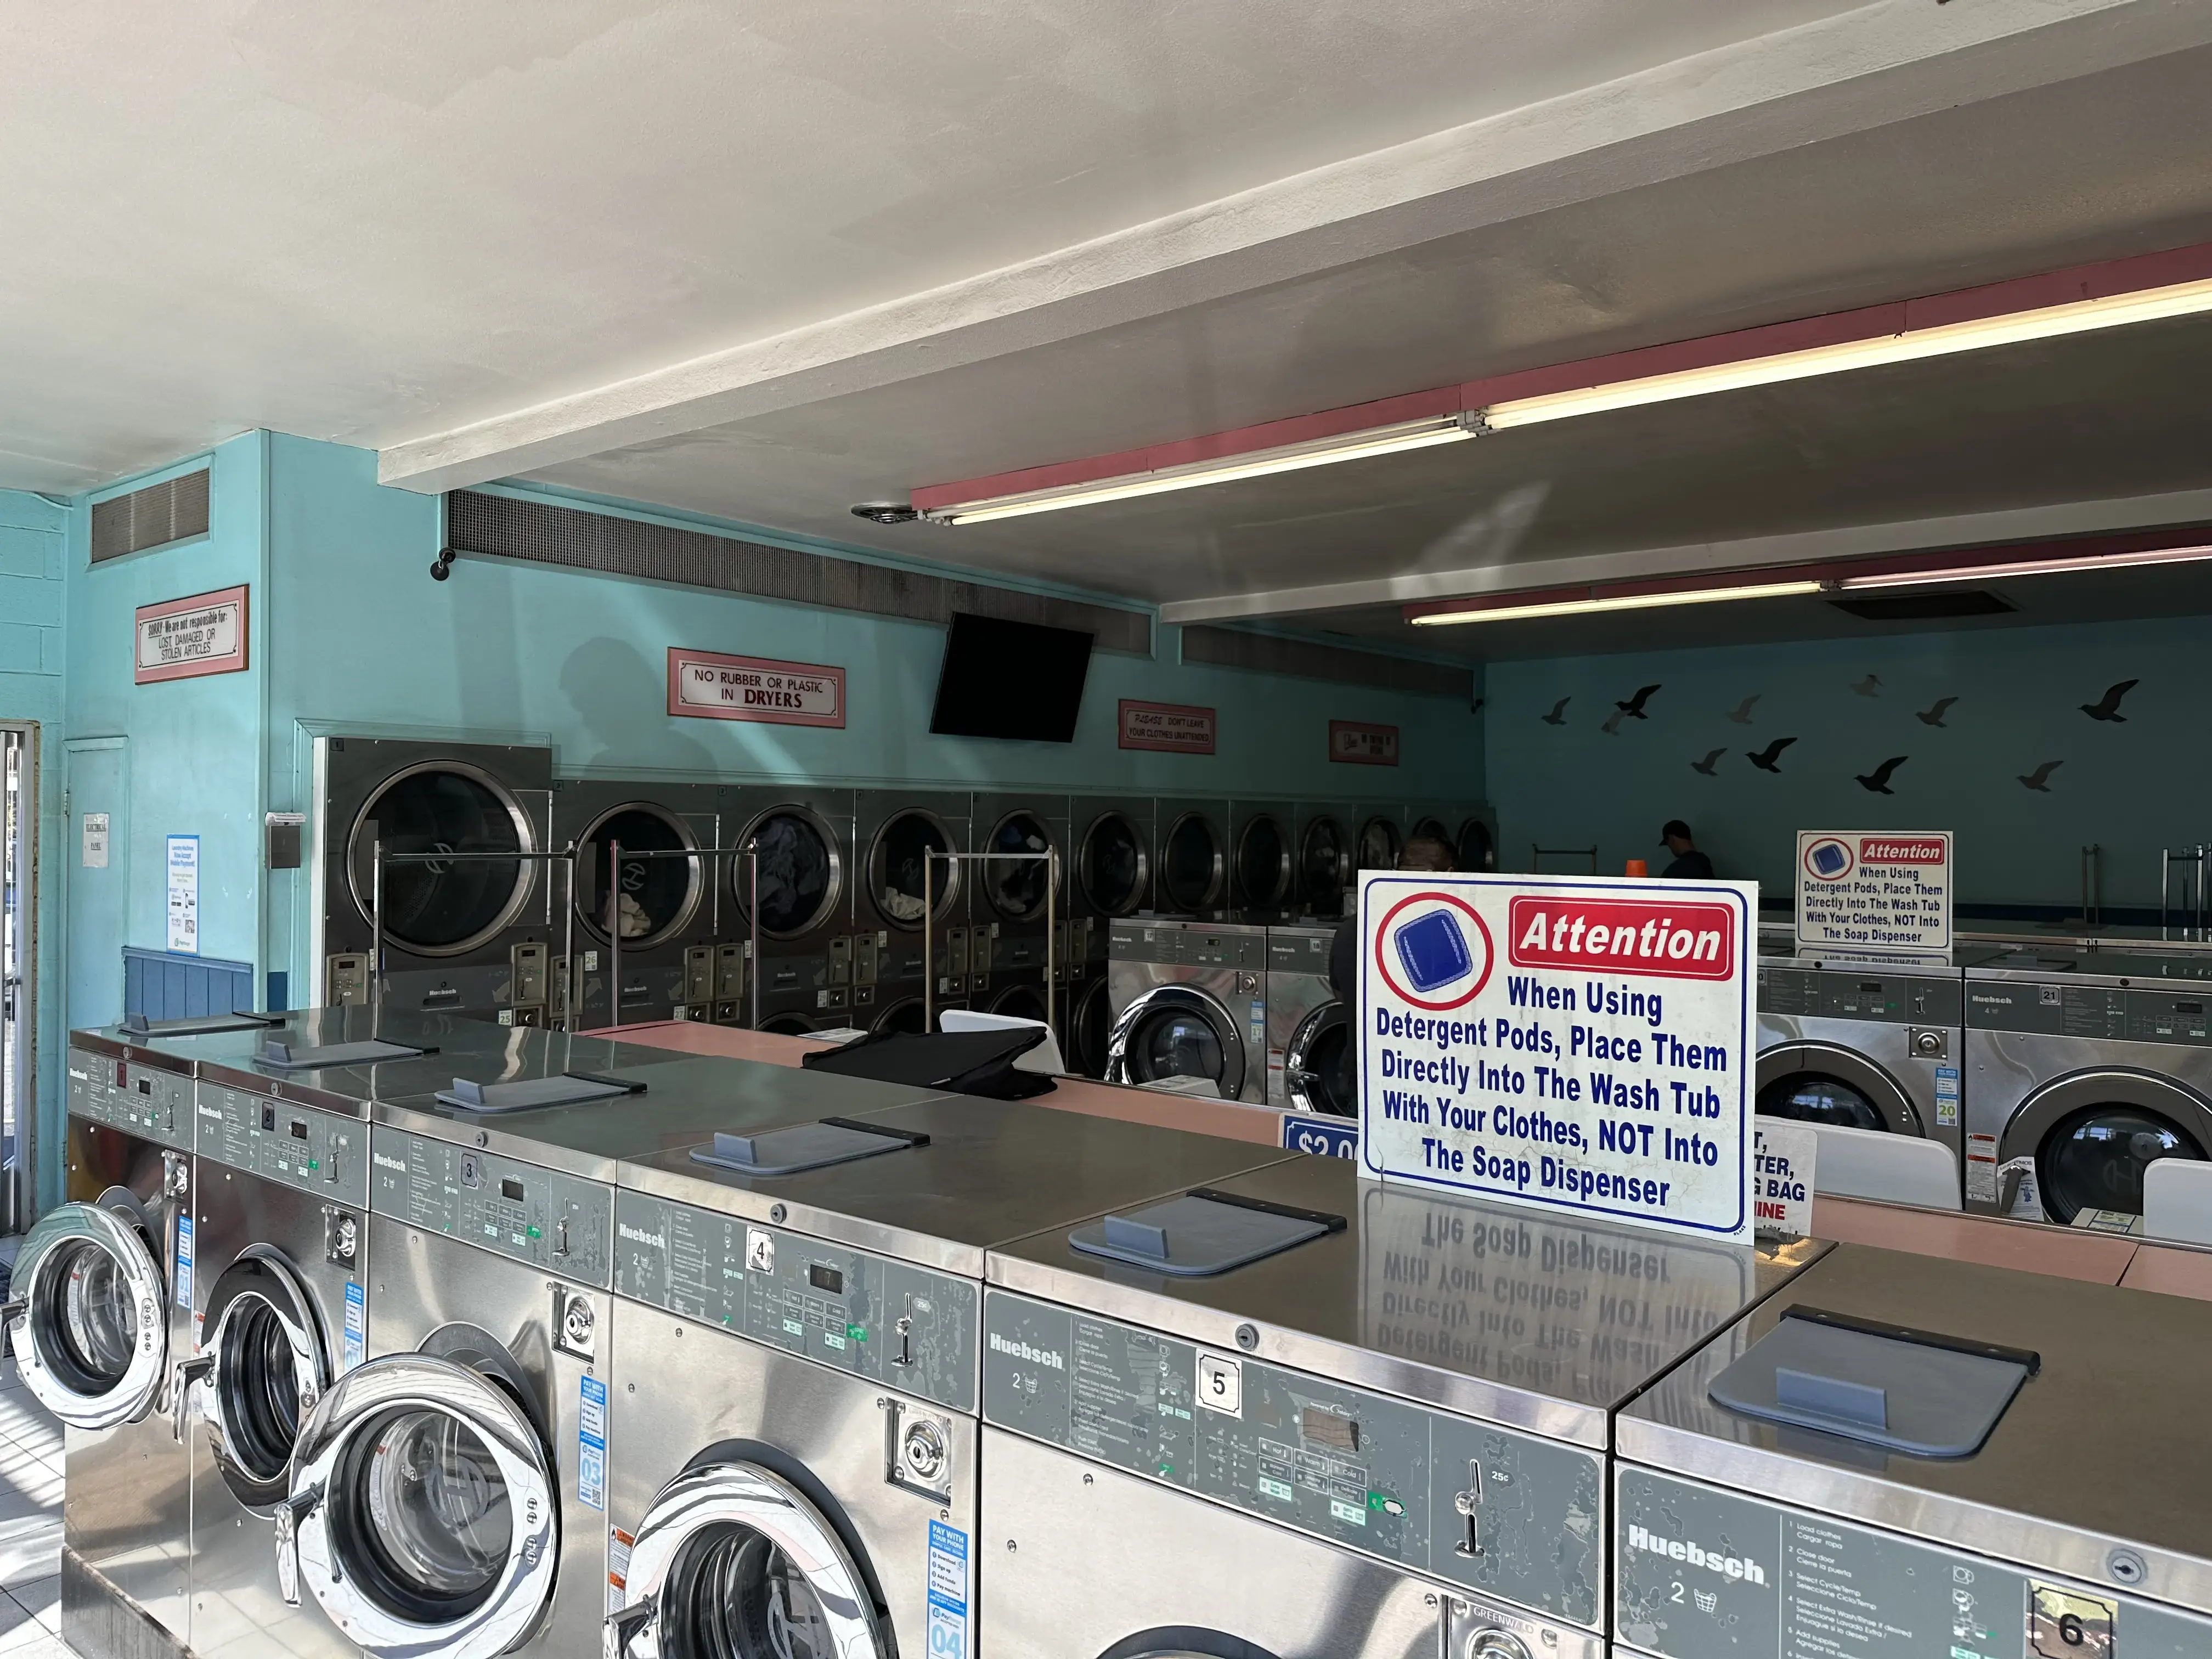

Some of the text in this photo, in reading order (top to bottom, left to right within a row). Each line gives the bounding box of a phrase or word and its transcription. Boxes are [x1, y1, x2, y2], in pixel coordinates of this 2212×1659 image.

[189, 612, 217, 628] responsible
[176, 628, 215, 645] DAMAGED OR
[161, 642, 210, 660] STOLEN ARTICLES
[695, 669, 823, 693] NO RUBBER OR PLASTIC
[721, 688, 802, 708] IN DRYERS
[1168, 718, 1186, 726] DON'T
[1187, 720, 1204, 728] LEAVE
[1129, 727, 1209, 741] YOUR CLOTHES UNATTENDED
[1864, 844, 1939, 859] Attention
[1859, 867, 1918, 881] When Using
[1804, 881, 1942, 896] Detergent Pods, Place Them
[1806, 896, 1940, 911] Directly Into The Wash Tub
[1806, 912, 1939, 928] With Your Clothes, NOT Into
[1519, 911, 1720, 962] Attention
[1823, 928, 1921, 943] The Soap Dispenser
[586, 956, 596, 964] 26
[1507, 975, 1662, 1027] When Using
[1972, 995, 2012, 1004] Huebsch
[2044, 991, 2055, 1000] 21
[500, 1014, 510, 1023] 25
[1252, 1028, 1262, 1036] 17
[1376, 1007, 1726, 1072] Detergent Pods, Place Them
[120, 1070, 123, 1080] 1
[1381, 1049, 1720, 1119] Directly Into The Wash Tub
[199, 1104, 222, 1119] Huebsch
[266, 1110, 270, 1122] 2
[1939, 1105, 1955, 1116] 20
[205, 1124, 208, 1133] 2
[1383, 1090, 1718, 1166] With Your Clothes, NOT Into
[374, 1153, 405, 1171] Huebsch
[466, 1163, 472, 1178] 3
[1421, 1137, 1671, 1206] The Soap Dispenser
[383, 1177, 387, 1187] 2
[1767, 1180, 1805, 1201] BAG
[619, 1223, 665, 1249] Huebsch
[757, 1242, 764, 1260] 4
[633, 1253, 638, 1266] 2
[179, 1274, 188, 1292] 01
[990, 1333, 1063, 1369] Huebsch
[592, 1383, 603, 1392] WITH
[1013, 1373, 1020, 1389] 2
[1212, 1370, 1225, 1395] 5
[1305, 1457, 1320, 1466] Warm
[582, 1458, 601, 1485] 03
[1343, 1469, 1356, 1478] Cold
[1491, 1471, 1509, 1482] 25¢
[933, 1525, 963, 1544] PAY WITH
[1796, 1523, 1815, 1533] Load
[933, 1533, 964, 1550] YOUR PHONE
[1796, 1532, 1843, 1550] Cargar ropa
[938, 1554, 956, 1565] Download
[1628, 1523, 1764, 1585] Huebsch
[1796, 1548, 1816, 1559] Close
[1818, 1555, 1835, 1564] door
[1796, 1556, 1817, 1568] Cierre
[1828, 1566, 1852, 1578] puerta
[1796, 1572, 1818, 1584] Select
[945, 1587, 960, 1596] machine
[1671, 1581, 1685, 1604] 2
[1796, 1581, 1835, 1598] Seleccione
[1474, 1607, 1534, 1634] GREENWALD
[1796, 1598, 1818, 1610] Select
[1819, 1604, 1836, 1615] Extra
[1884, 1624, 1912, 1638] desired
[1796, 1606, 1882, 1637] Seleccione Lavado Extra
[1796, 1614, 1829, 1629] Enjuague
[1846, 1629, 1869, 1641] desea
[2059, 1613, 2084, 1646] 6
[932, 1624, 962, 1659] 04
[1796, 1629, 1811, 1639] Add
[1812, 1635, 1840, 1649] supplies
[1796, 1638, 1825, 1652] Agregar
